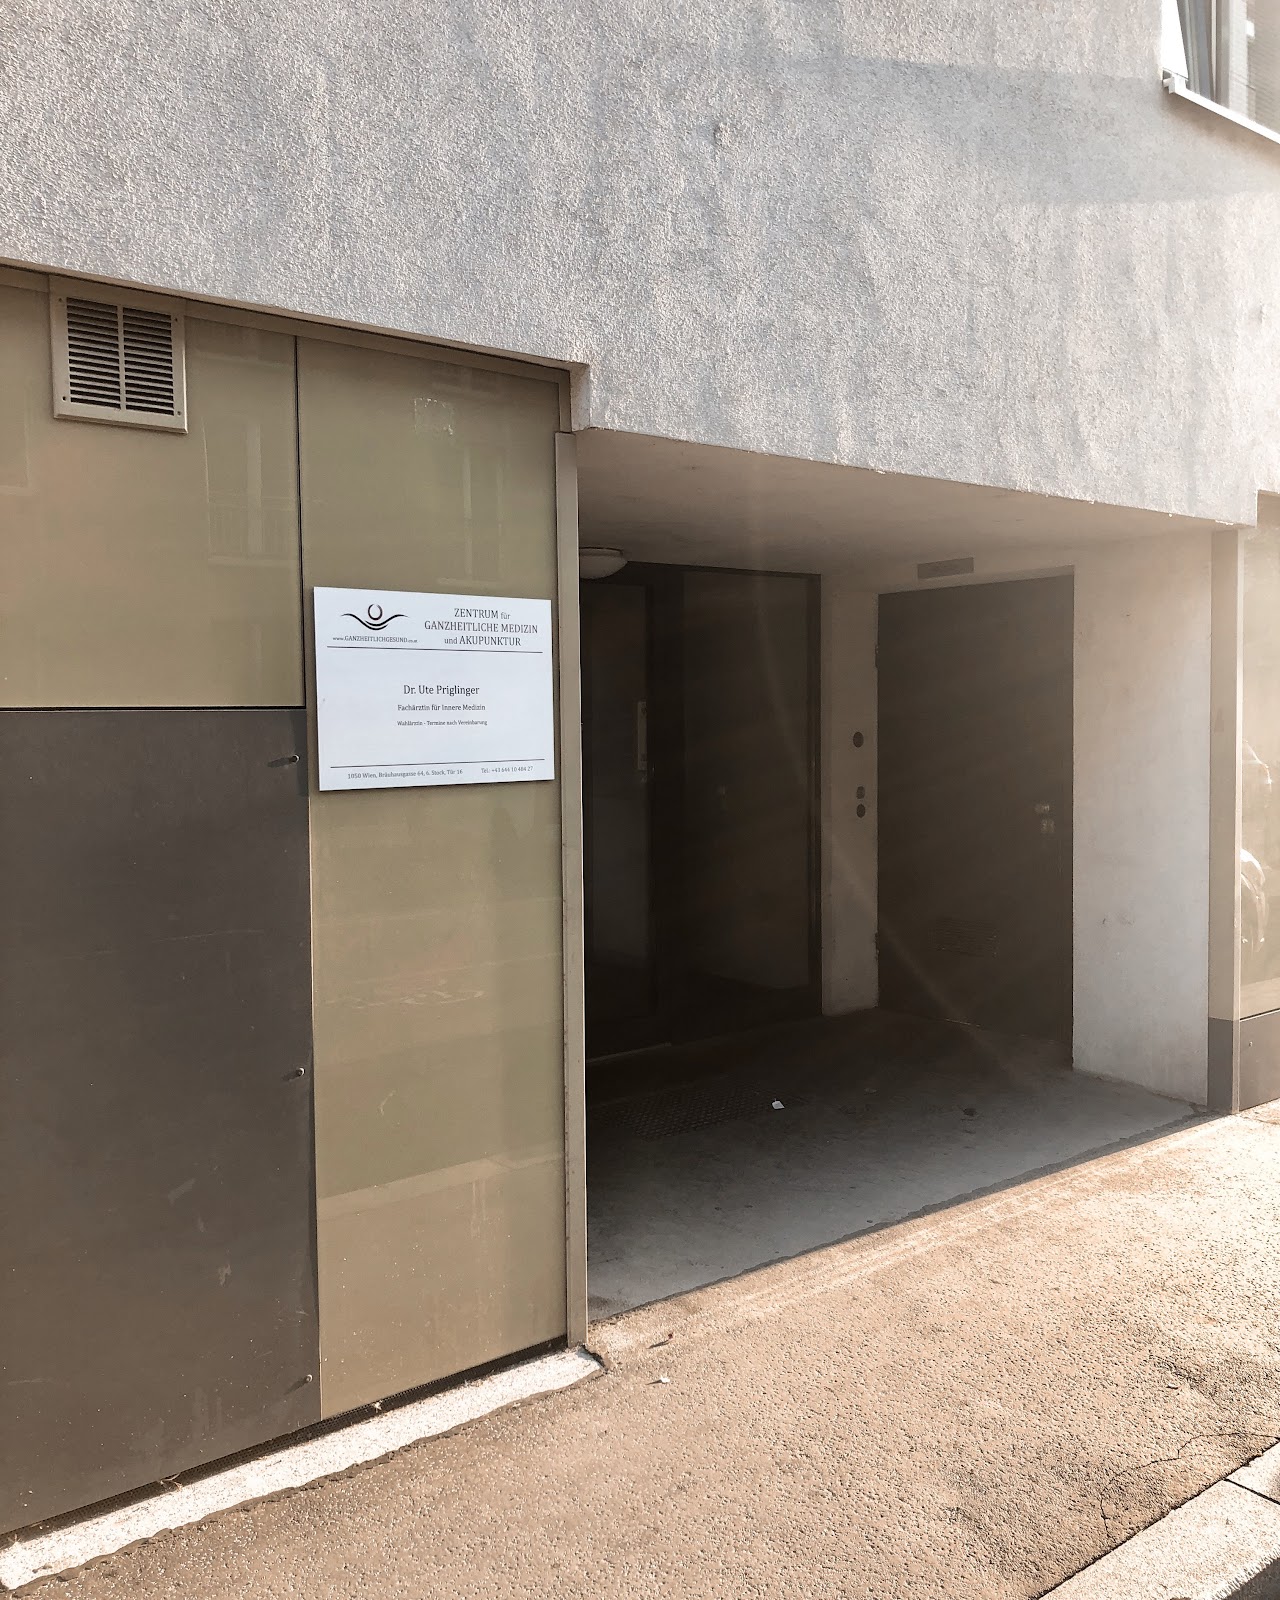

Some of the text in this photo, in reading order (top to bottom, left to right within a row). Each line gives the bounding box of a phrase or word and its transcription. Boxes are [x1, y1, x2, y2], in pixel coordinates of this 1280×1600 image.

[454, 607, 511, 620] ZENTRUM für
[424, 620, 538, 634] GANZHEITLICHE MEDIZIN
[444, 635, 521, 647] und AKUPUNKTUR
[403, 684, 480, 697] Dr. Ute Priglinger
[397, 703, 486, 712] Fachärztin für Innere Medizin
[362, 771, 378, 779] Wien,
